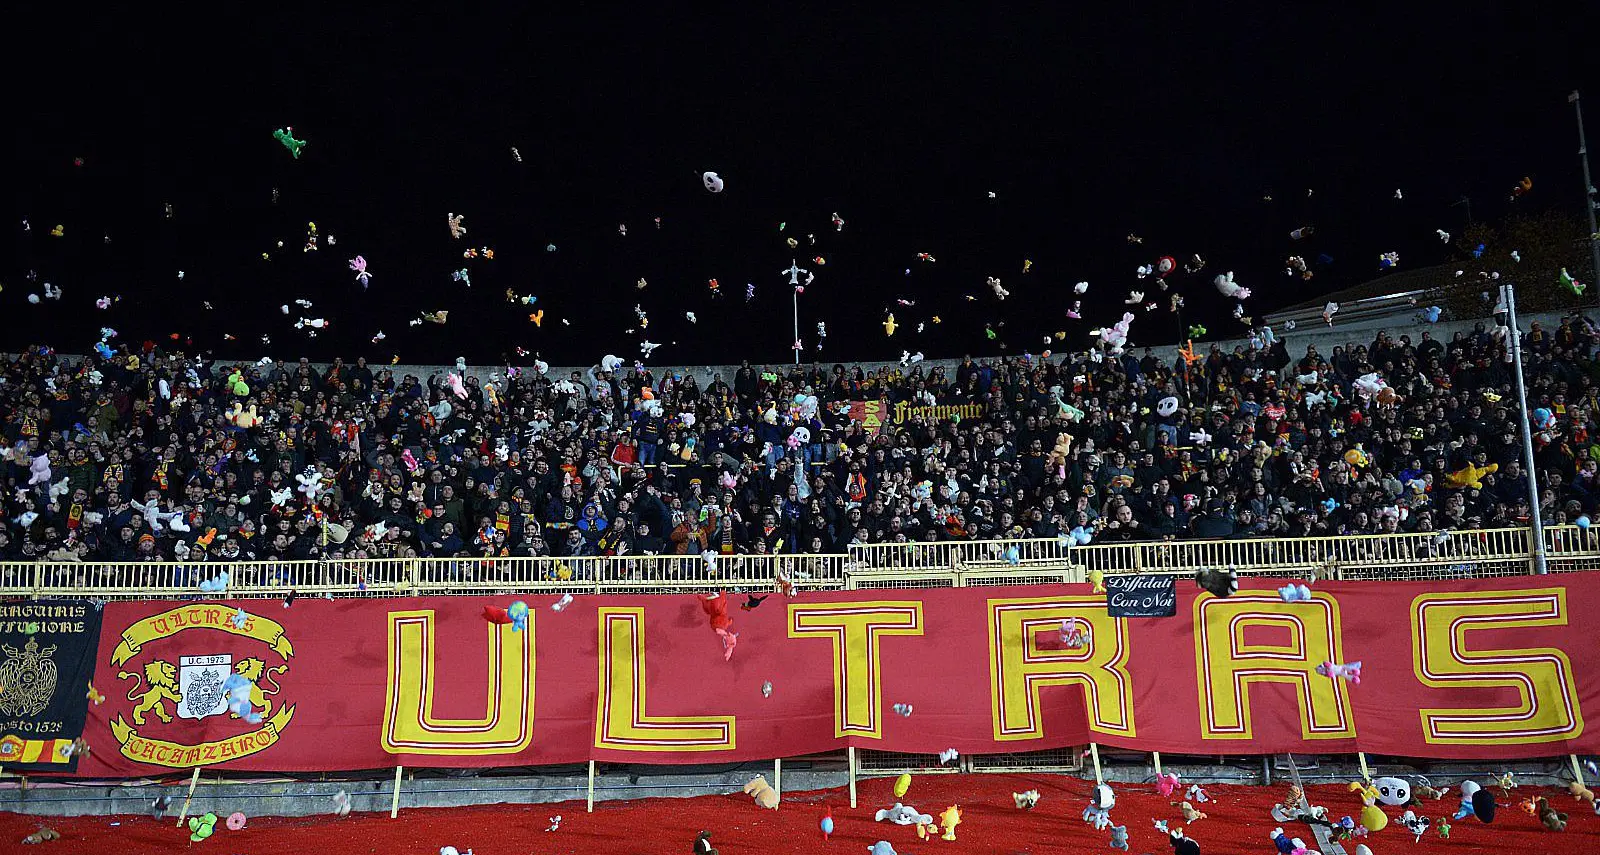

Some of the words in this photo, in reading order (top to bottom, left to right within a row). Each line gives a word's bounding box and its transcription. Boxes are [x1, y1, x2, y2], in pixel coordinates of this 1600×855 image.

[1107, 575, 1174, 592] Diffidati
[1111, 592, 1139, 607] Con
[1142, 592, 1175, 608] Noi
[150, 609, 255, 633] ULTRAS
[188, 657, 205, 665] U.C.
[206, 656, 225, 664] 1973
[381, 586, 1585, 755] ULTRAS
[129, 730, 271, 764] CATANZARO
